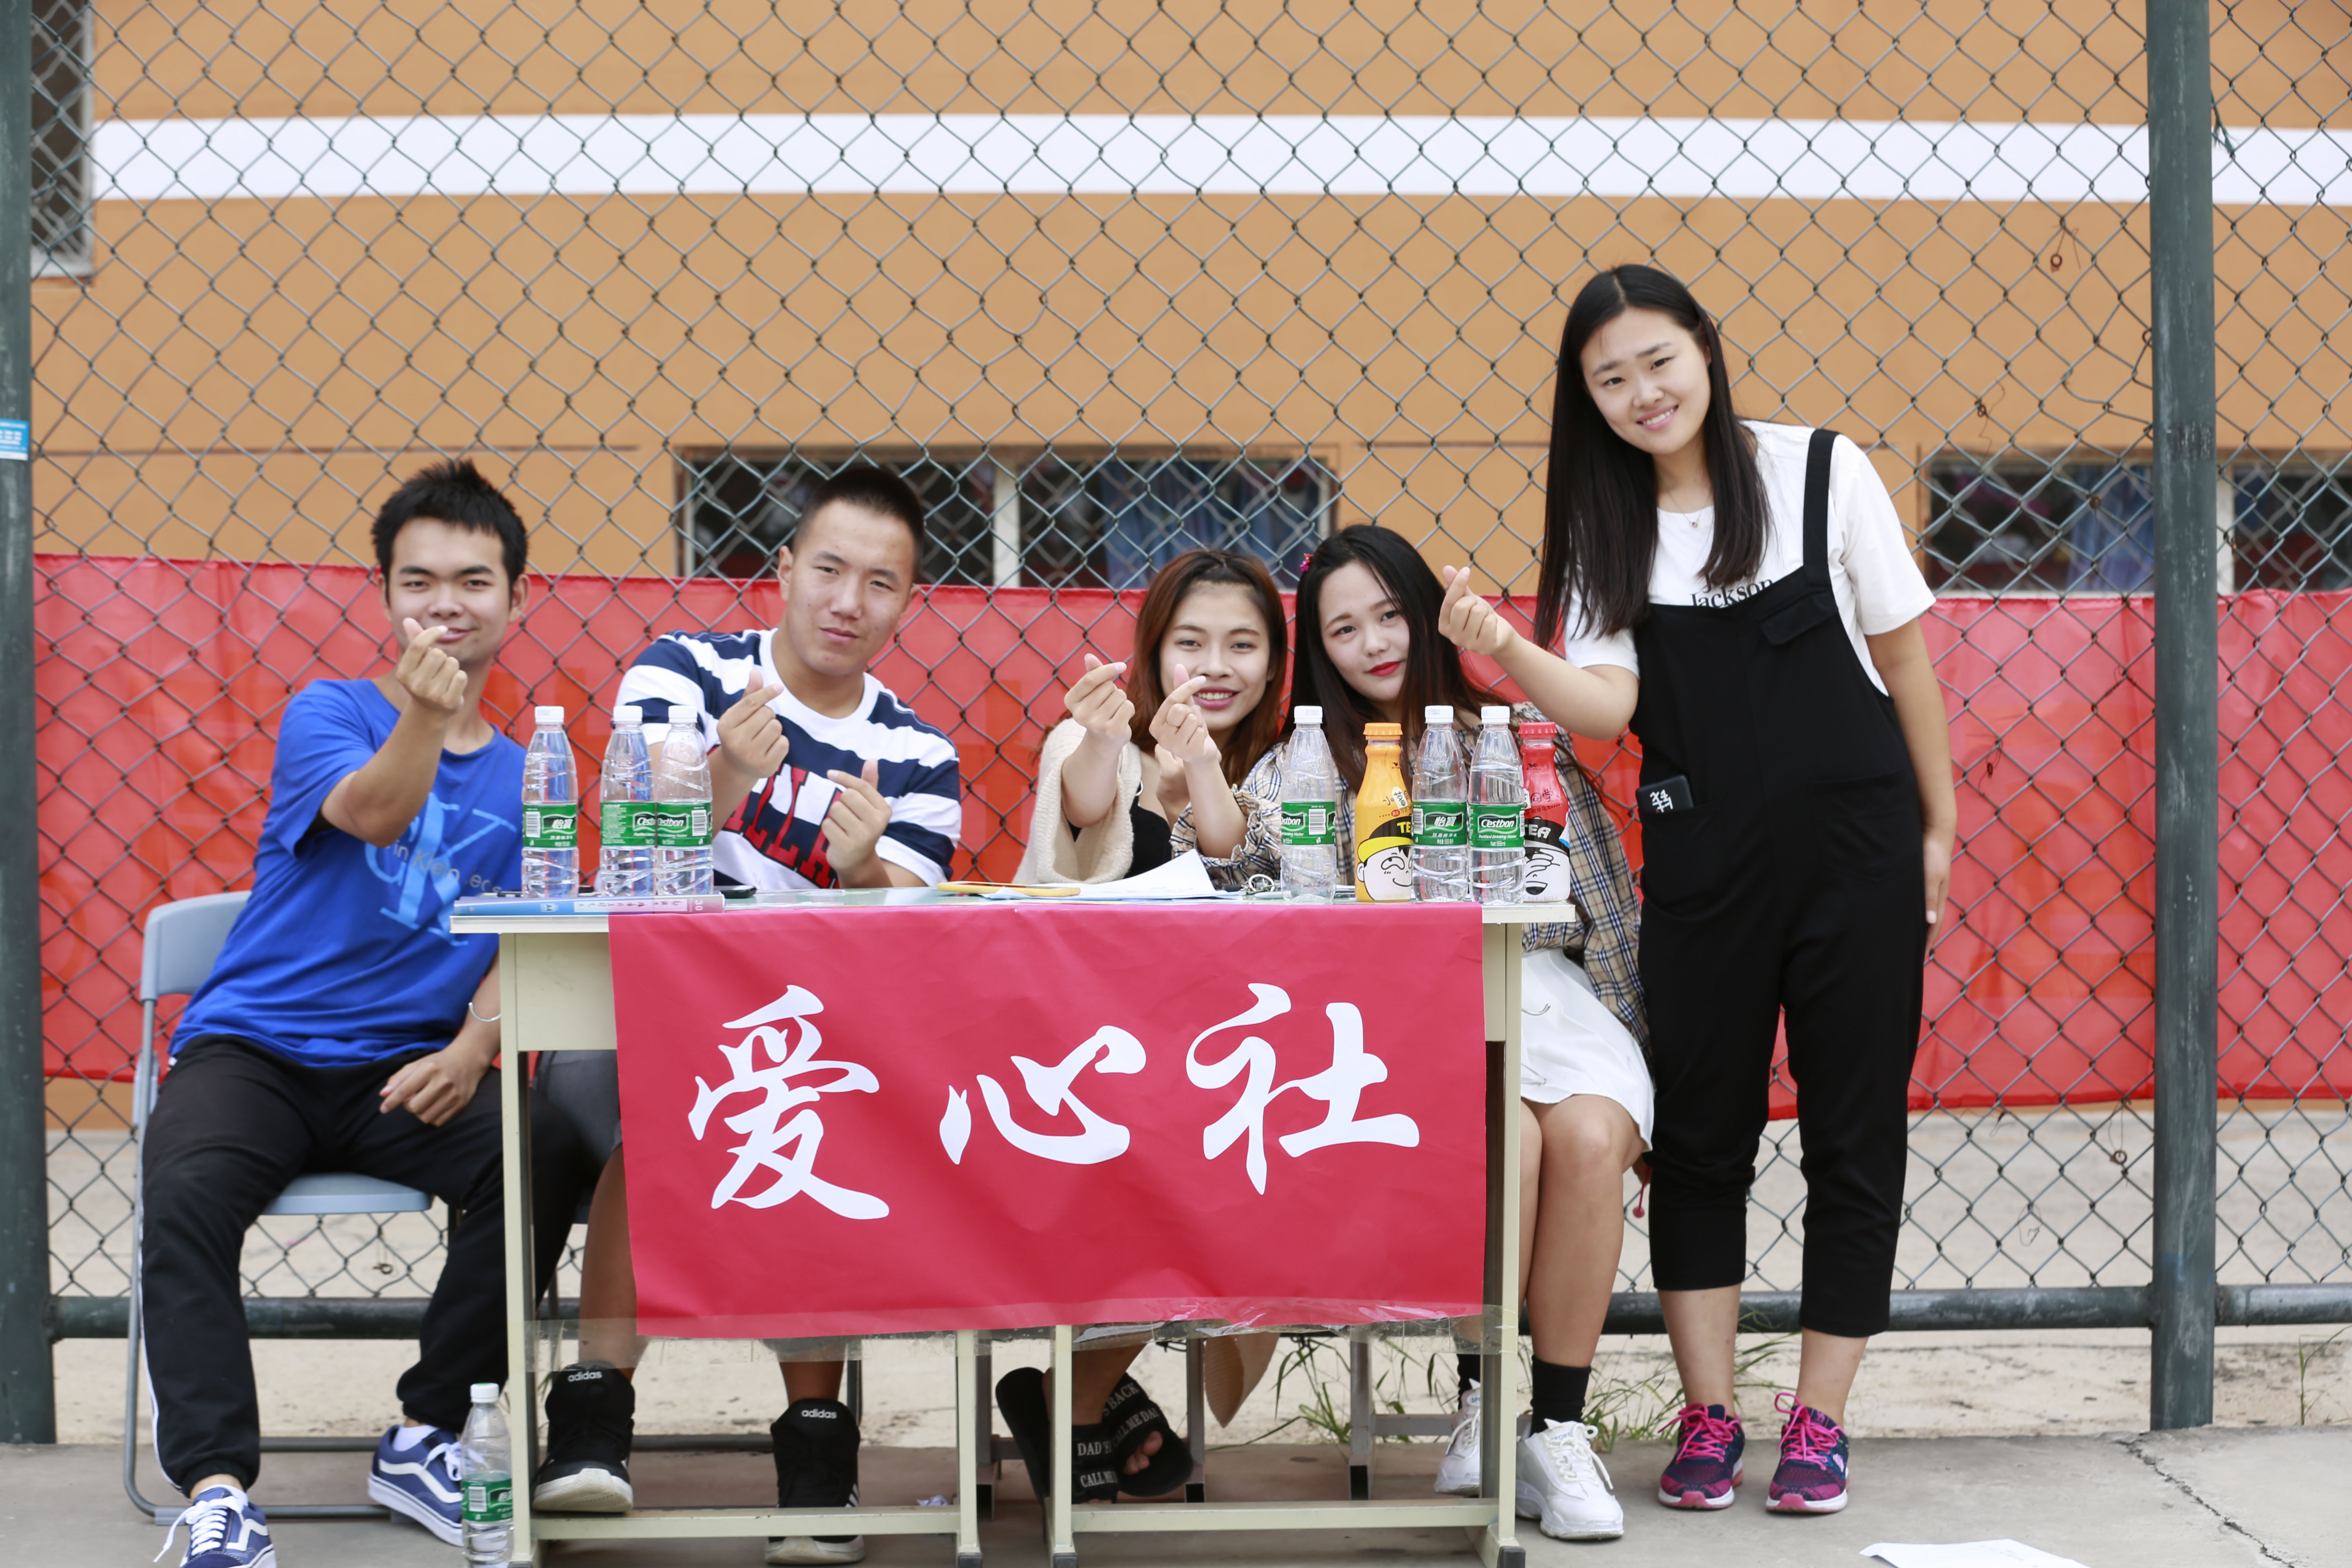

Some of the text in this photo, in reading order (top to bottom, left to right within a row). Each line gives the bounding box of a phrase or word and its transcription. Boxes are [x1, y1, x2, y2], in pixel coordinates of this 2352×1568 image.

[1281, 817, 1301, 825] estbon
[1396, 821, 1412, 833] TE
[695, 900, 703, 911] 30
[688, 982, 1420, 1220] 爱心社
[568, 1370, 602, 1382] adidas
[1107, 1383, 1140, 1410] BACK
[801, 1409, 837, 1419] adidas
[1125, 1414, 1143, 1430] ME
[1077, 1441, 1102, 1456] DAD
[1080, 1472, 1105, 1488] CALL
